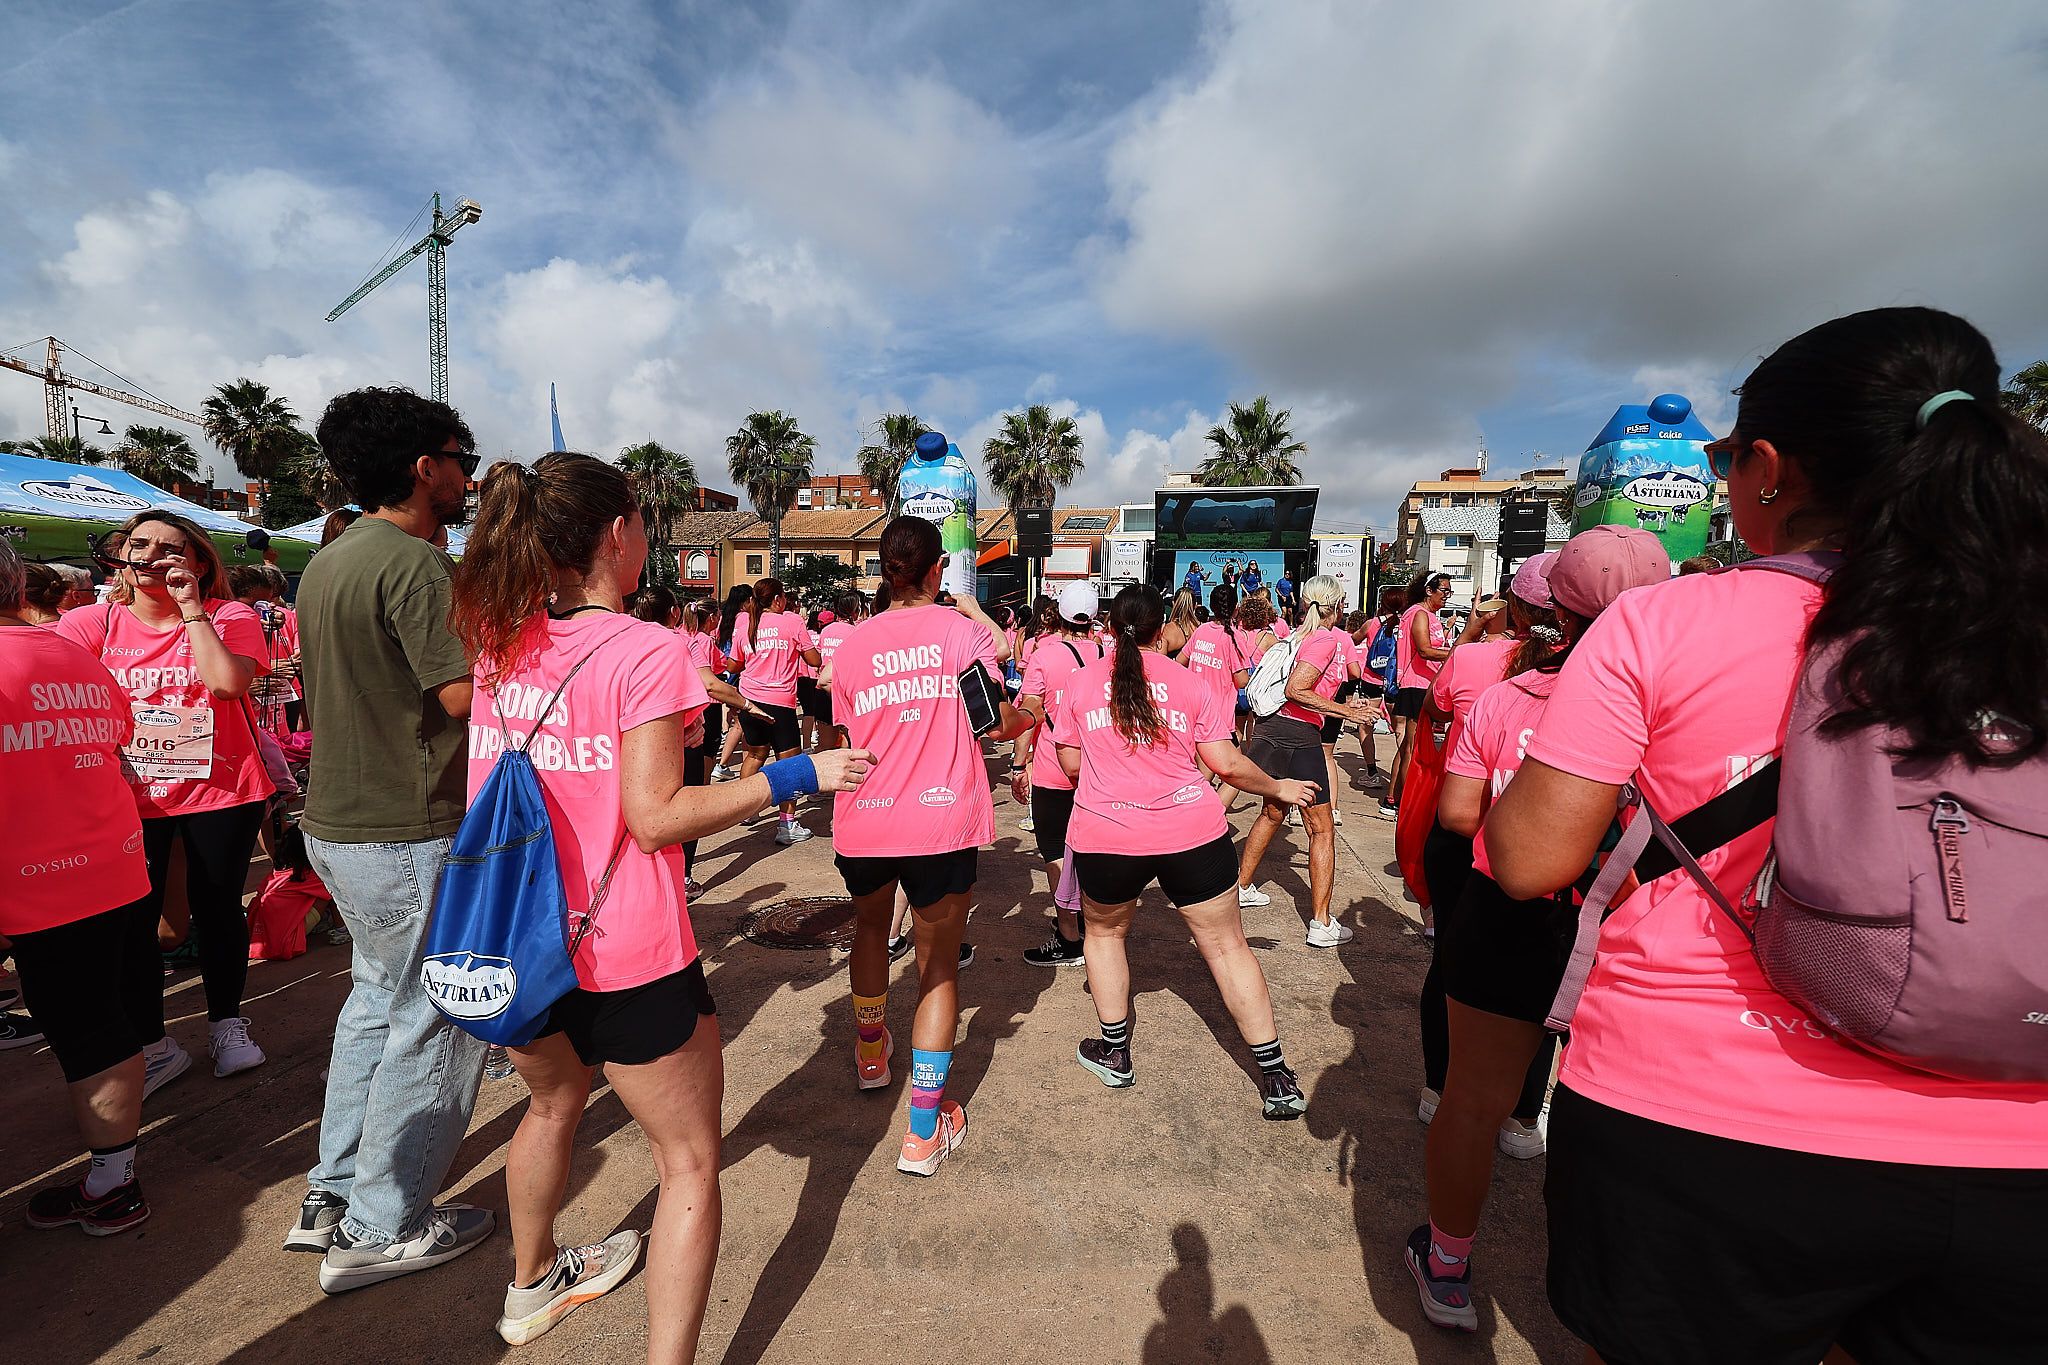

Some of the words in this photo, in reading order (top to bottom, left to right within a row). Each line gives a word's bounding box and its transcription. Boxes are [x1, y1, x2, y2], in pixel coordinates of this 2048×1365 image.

[1658, 429, 1683, 439] Calcio
[1627, 483, 1702, 500] ASTURIANA
[904, 504, 952, 515] ASTURIANA
[757, 628, 779, 640] OMOS
[744, 640, 789, 655] IMARABLES
[1195, 639, 1216, 654] SOMOS
[872, 644, 942, 678] SOMOS
[30, 683, 112, 711] SOMOS
[138, 715, 177, 724] ASTURIANA
[898, 708, 921, 723] 2026
[0, 718, 127, 753] MPARABLES
[74, 753, 104, 769] 2026
[856, 797, 894, 809] OYSHO
[21, 854, 88, 876] OYSHO
[1740, 1010, 1826, 1039] OYS
[915, 1062, 934, 1071] PIES
[917, 1072, 944, 1081] SUELO
